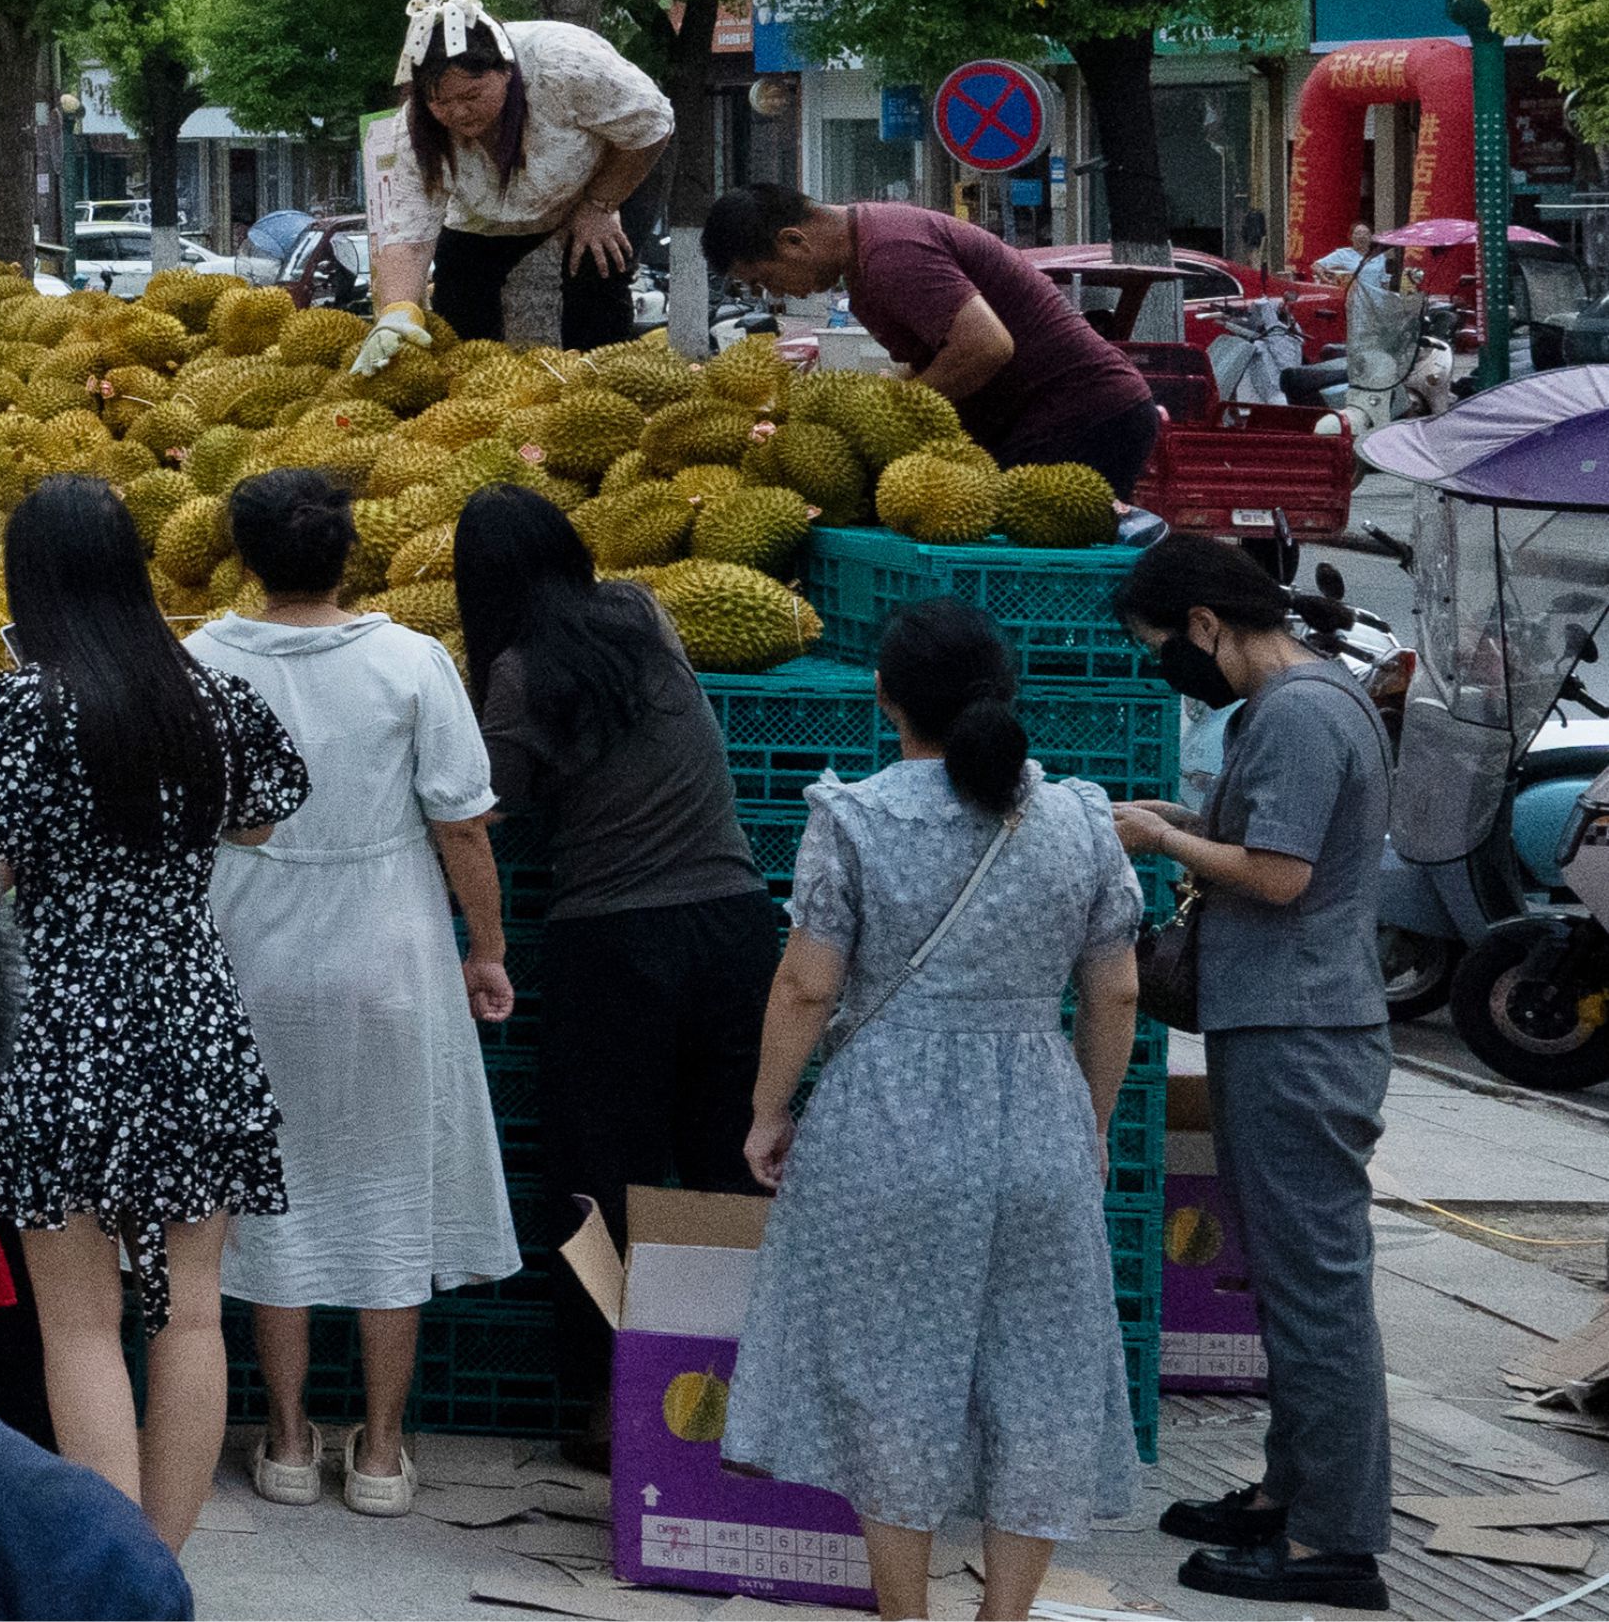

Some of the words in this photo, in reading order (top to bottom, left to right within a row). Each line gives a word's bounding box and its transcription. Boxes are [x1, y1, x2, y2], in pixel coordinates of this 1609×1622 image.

[754, 1531, 765, 1546] 5
[779, 1533, 790, 1549] 6
[804, 1536, 814, 1551] 7
[827, 1538, 839, 1554] 8
[754, 1556, 765, 1572] 5
[779, 1559, 790, 1574] 6
